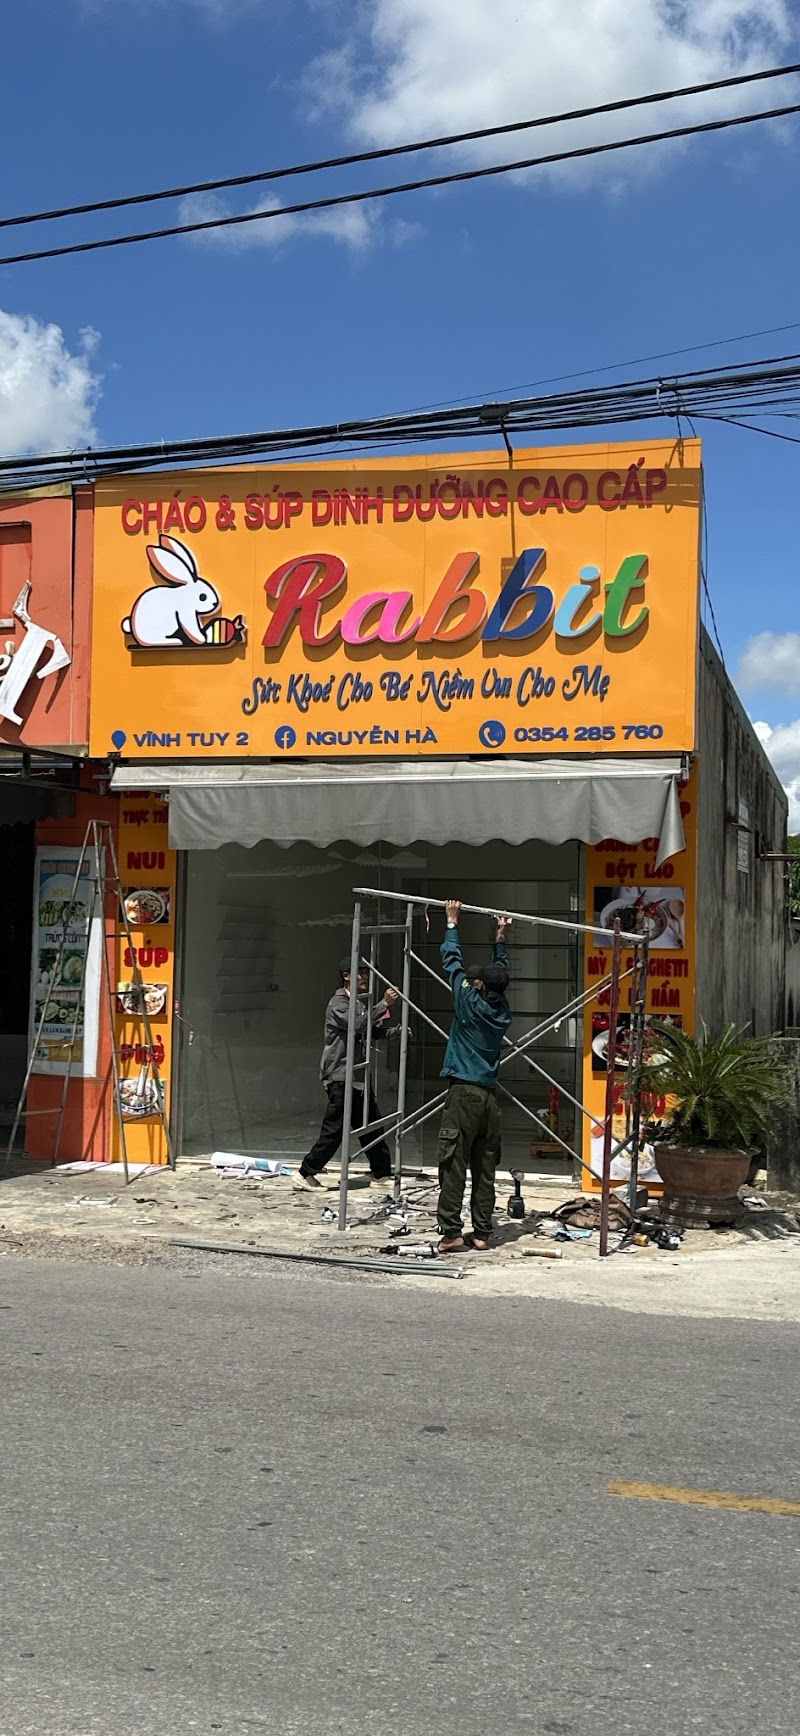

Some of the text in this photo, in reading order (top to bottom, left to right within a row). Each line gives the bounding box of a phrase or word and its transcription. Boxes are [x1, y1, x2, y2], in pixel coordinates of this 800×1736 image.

[121, 457, 667, 533] CHÁO & SÚP DINH DƯỠNG CAO CẤP
[262, 548, 650, 648] Rabbit
[242, 677, 281, 716] Sức
[337, 672, 373, 711] Cho
[380, 671, 413, 701] Bé
[417, 668, 474, 712] Niềm
[517, 667, 556, 707] Cho
[562, 665, 610, 702] Mẹ
[133, 731, 249, 747] VĨNH TUY 2
[306, 725, 438, 745] NGUYỄN HÀ
[514, 725, 664, 742] 0354 285 760
[127, 851, 165, 869] NUI
[605, 859, 637, 883] BỘT
[124, 939, 168, 968] SÚP
[626, 957, 688, 977] SGHETTI
